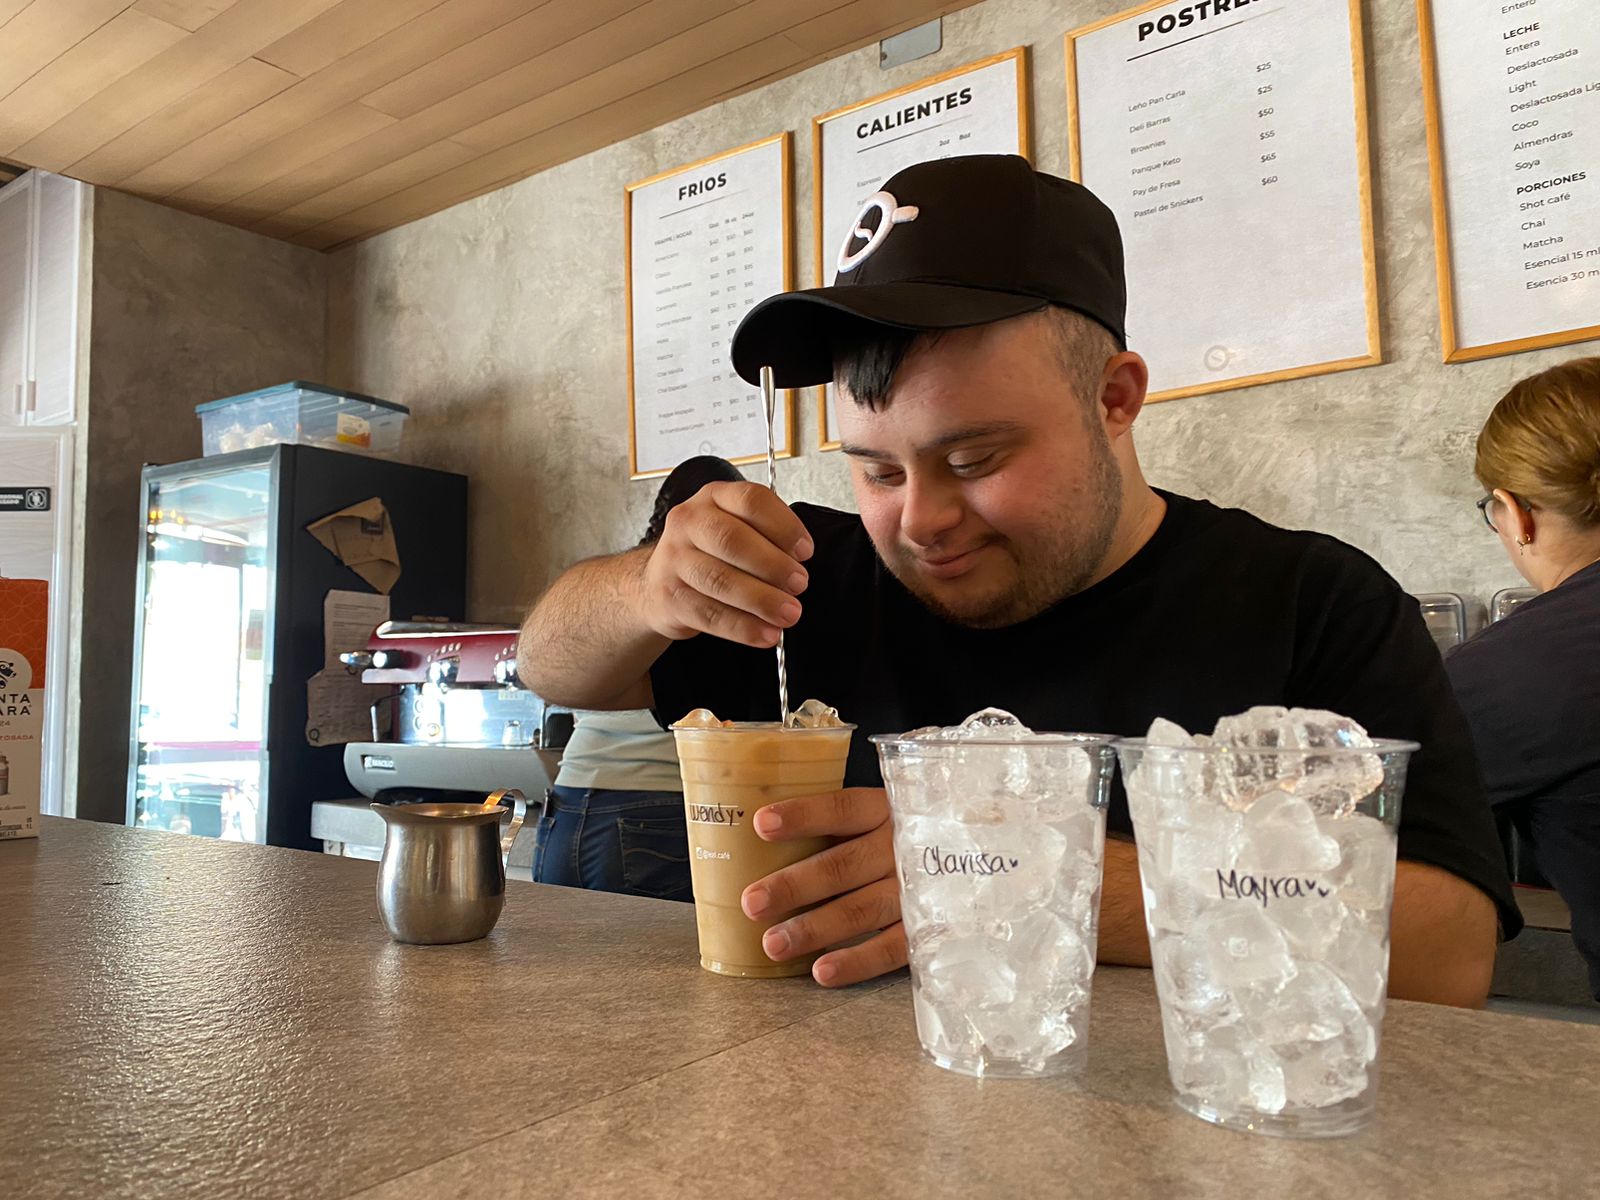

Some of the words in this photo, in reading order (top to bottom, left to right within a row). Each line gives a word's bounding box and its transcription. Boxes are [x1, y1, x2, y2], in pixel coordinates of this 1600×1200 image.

[1501, 0, 1536, 14] Entero
[1138, 0, 1259, 42] POSTRE
[1503, 22, 1540, 40] LECHE
[1505, 40, 1540, 55] Entera
[1507, 48, 1579, 75] Deslactosada
[1148, 96, 1164, 106] Pan
[1256, 61, 1272, 73] $25
[1508, 80, 1537, 94] Light
[1146, 116, 1171, 129] Barras
[1257, 84, 1273, 95] $25
[1510, 88, 1583, 113] Deslactosada
[856, 87, 973, 139] CALIENTES
[1130, 139, 1166, 154] Brownies
[1258, 107, 1274, 118] $50
[1511, 120, 1539, 132] Coco
[1163, 157, 1181, 167] Keto
[1259, 130, 1276, 141] $55
[1513, 130, 1574, 151] Almendras
[1132, 188, 1147, 196] Pay
[1148, 185, 1158, 193] de
[1160, 179, 1181, 189] Fresa
[1261, 152, 1277, 163] $65
[1515, 159, 1540, 171] Soya
[678, 172, 727, 201] FRIOS
[1516, 171, 1587, 195] PORCIONES
[1134, 206, 1157, 218] Pastel
[1158, 204, 1169, 212] de
[1170, 195, 1204, 209] Snickers
[1261, 175, 1278, 186] $60
[1520, 199, 1545, 212] Shot
[1547, 192, 1571, 205] café
[1521, 218, 1546, 231] Chai
[1523, 235, 1564, 250] Matcha
[1524, 253, 1570, 270] Esencial
[1572, 250, 1583, 260] 15
[1526, 275, 1568, 290] Esencia
[1571, 271, 1585, 281] 30
[923, 845, 1010, 876] Clarissa
[1216, 868, 1306, 908] Mayra
